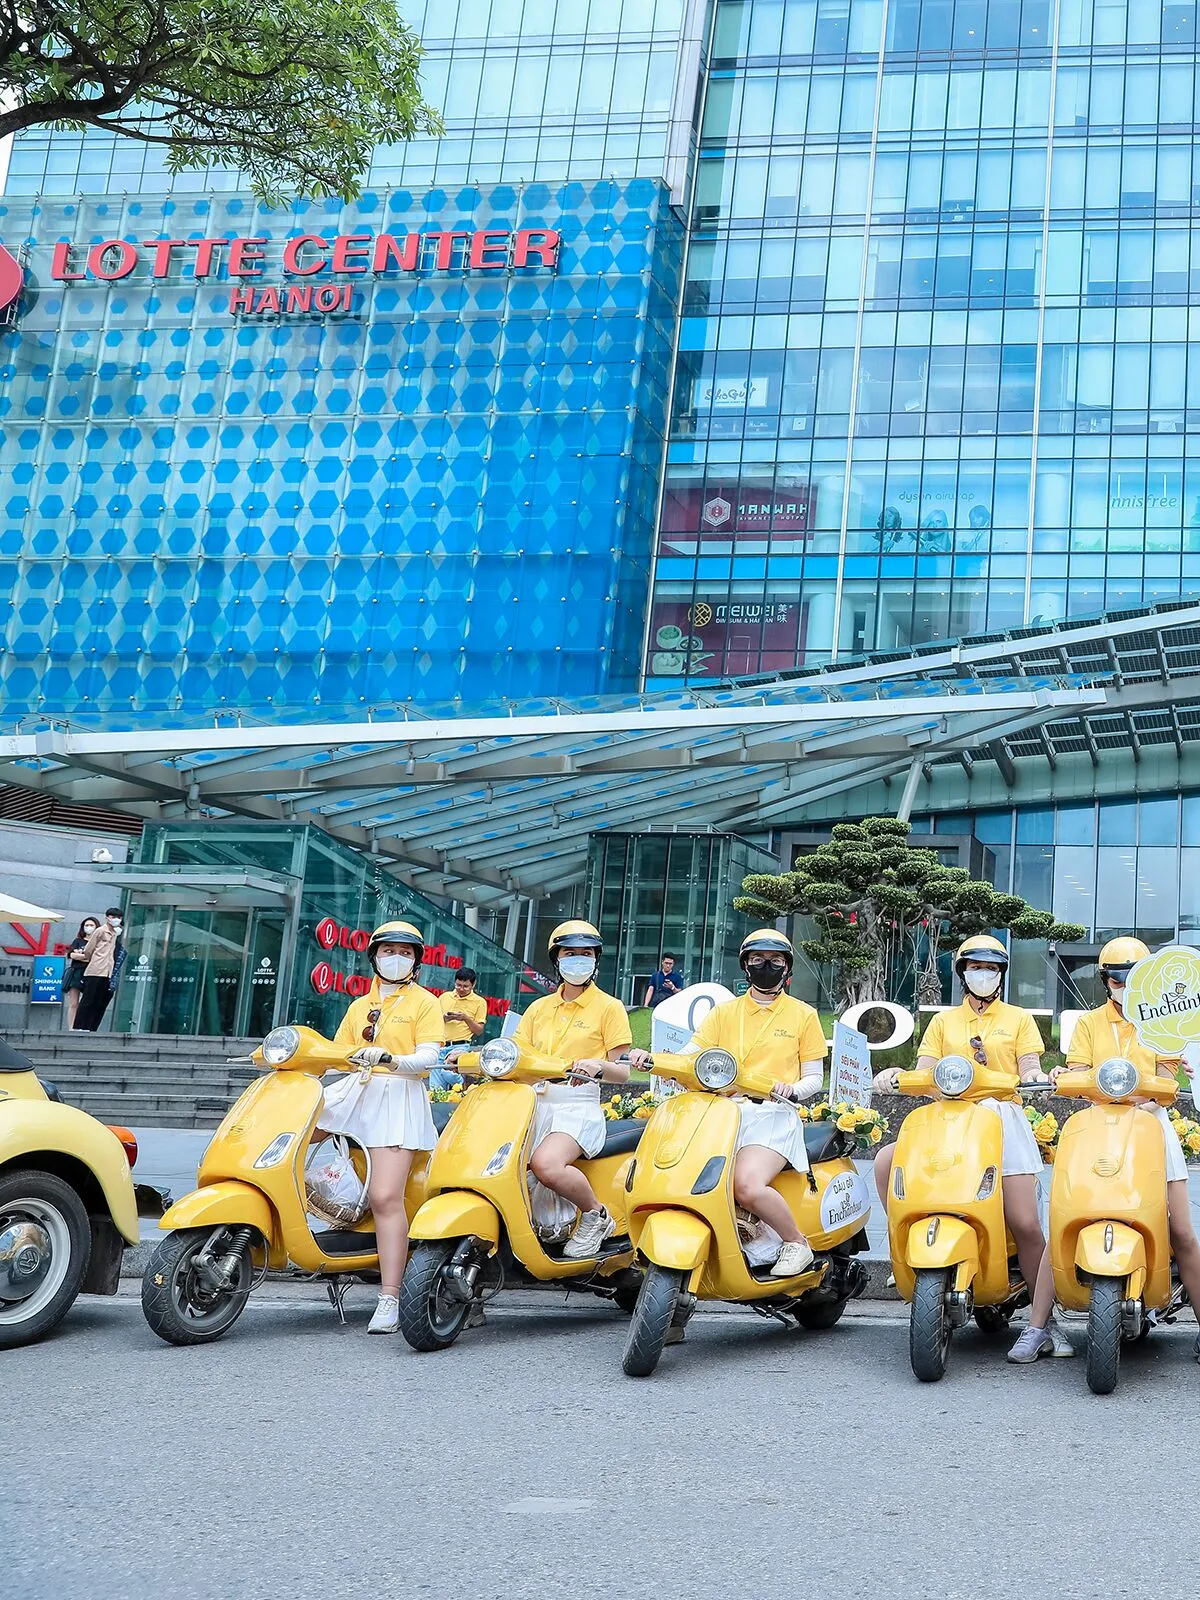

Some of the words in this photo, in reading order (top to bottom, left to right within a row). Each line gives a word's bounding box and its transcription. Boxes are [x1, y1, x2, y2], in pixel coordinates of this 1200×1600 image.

[51, 238, 268, 280] LOTTE
[283, 228, 560, 276] CENTER
[229, 284, 354, 315] HANOI
[898, 490, 932, 503] dysn
